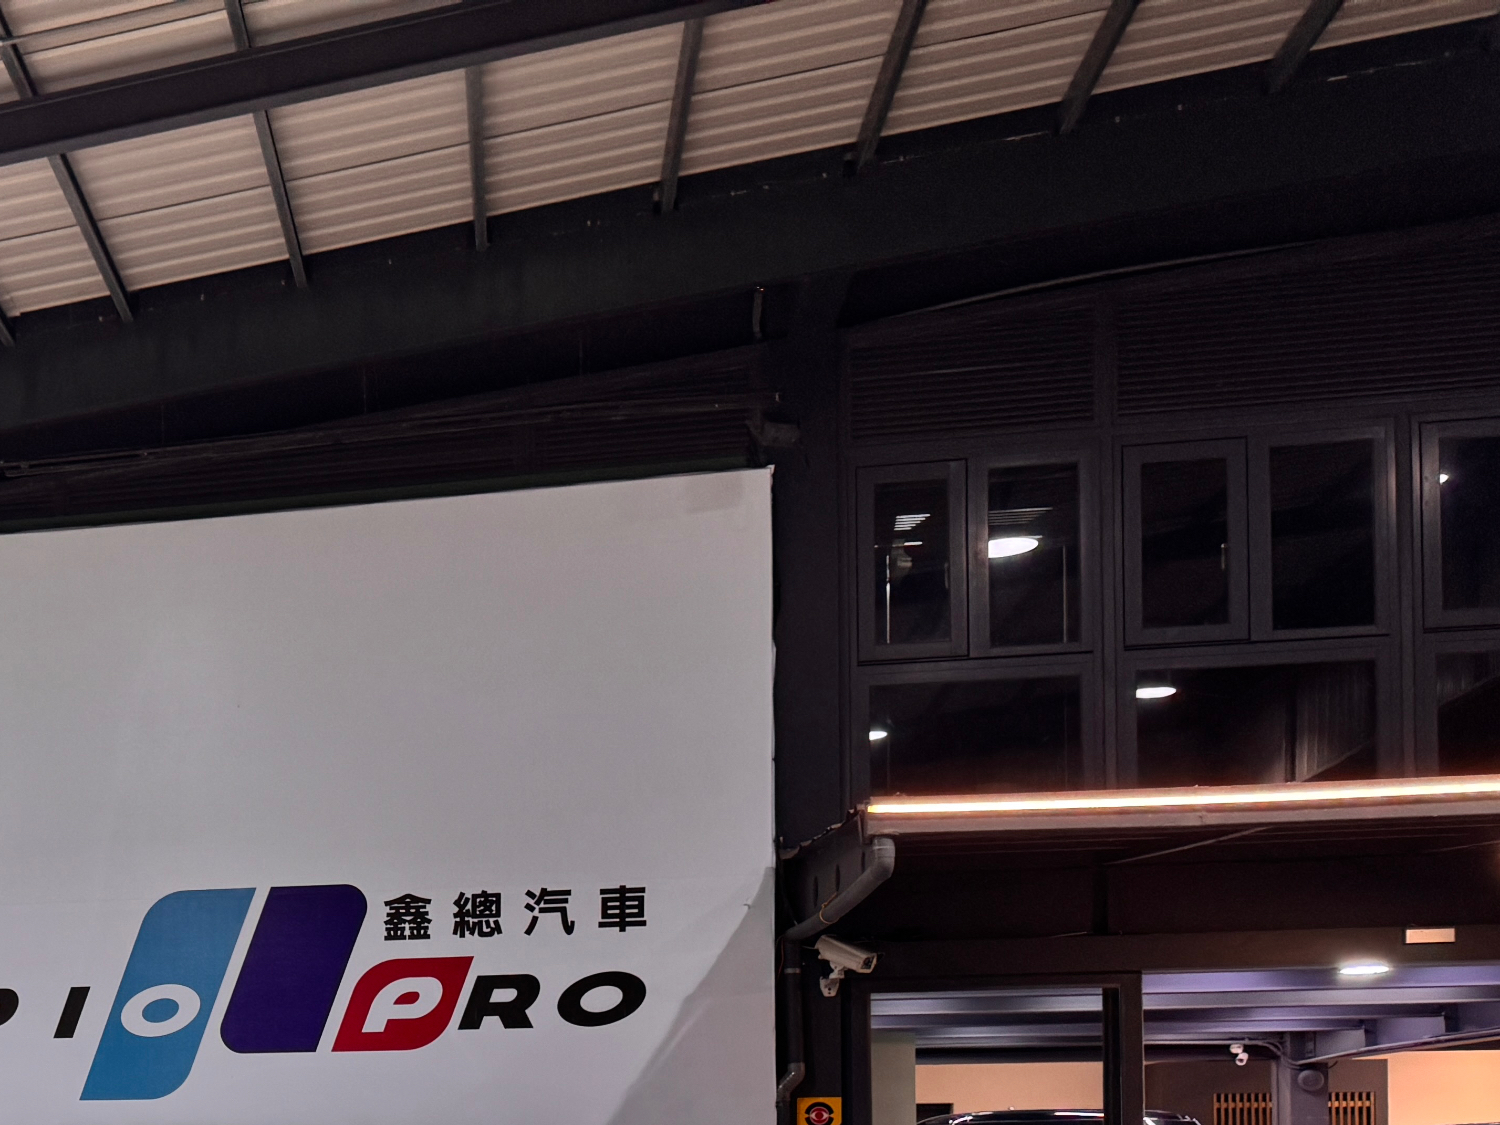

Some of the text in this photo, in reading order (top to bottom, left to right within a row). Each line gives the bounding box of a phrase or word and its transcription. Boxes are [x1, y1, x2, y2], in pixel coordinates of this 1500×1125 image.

[383, 885, 647, 941] 鑫總汽車
[361, 971, 647, 1033] PRO
